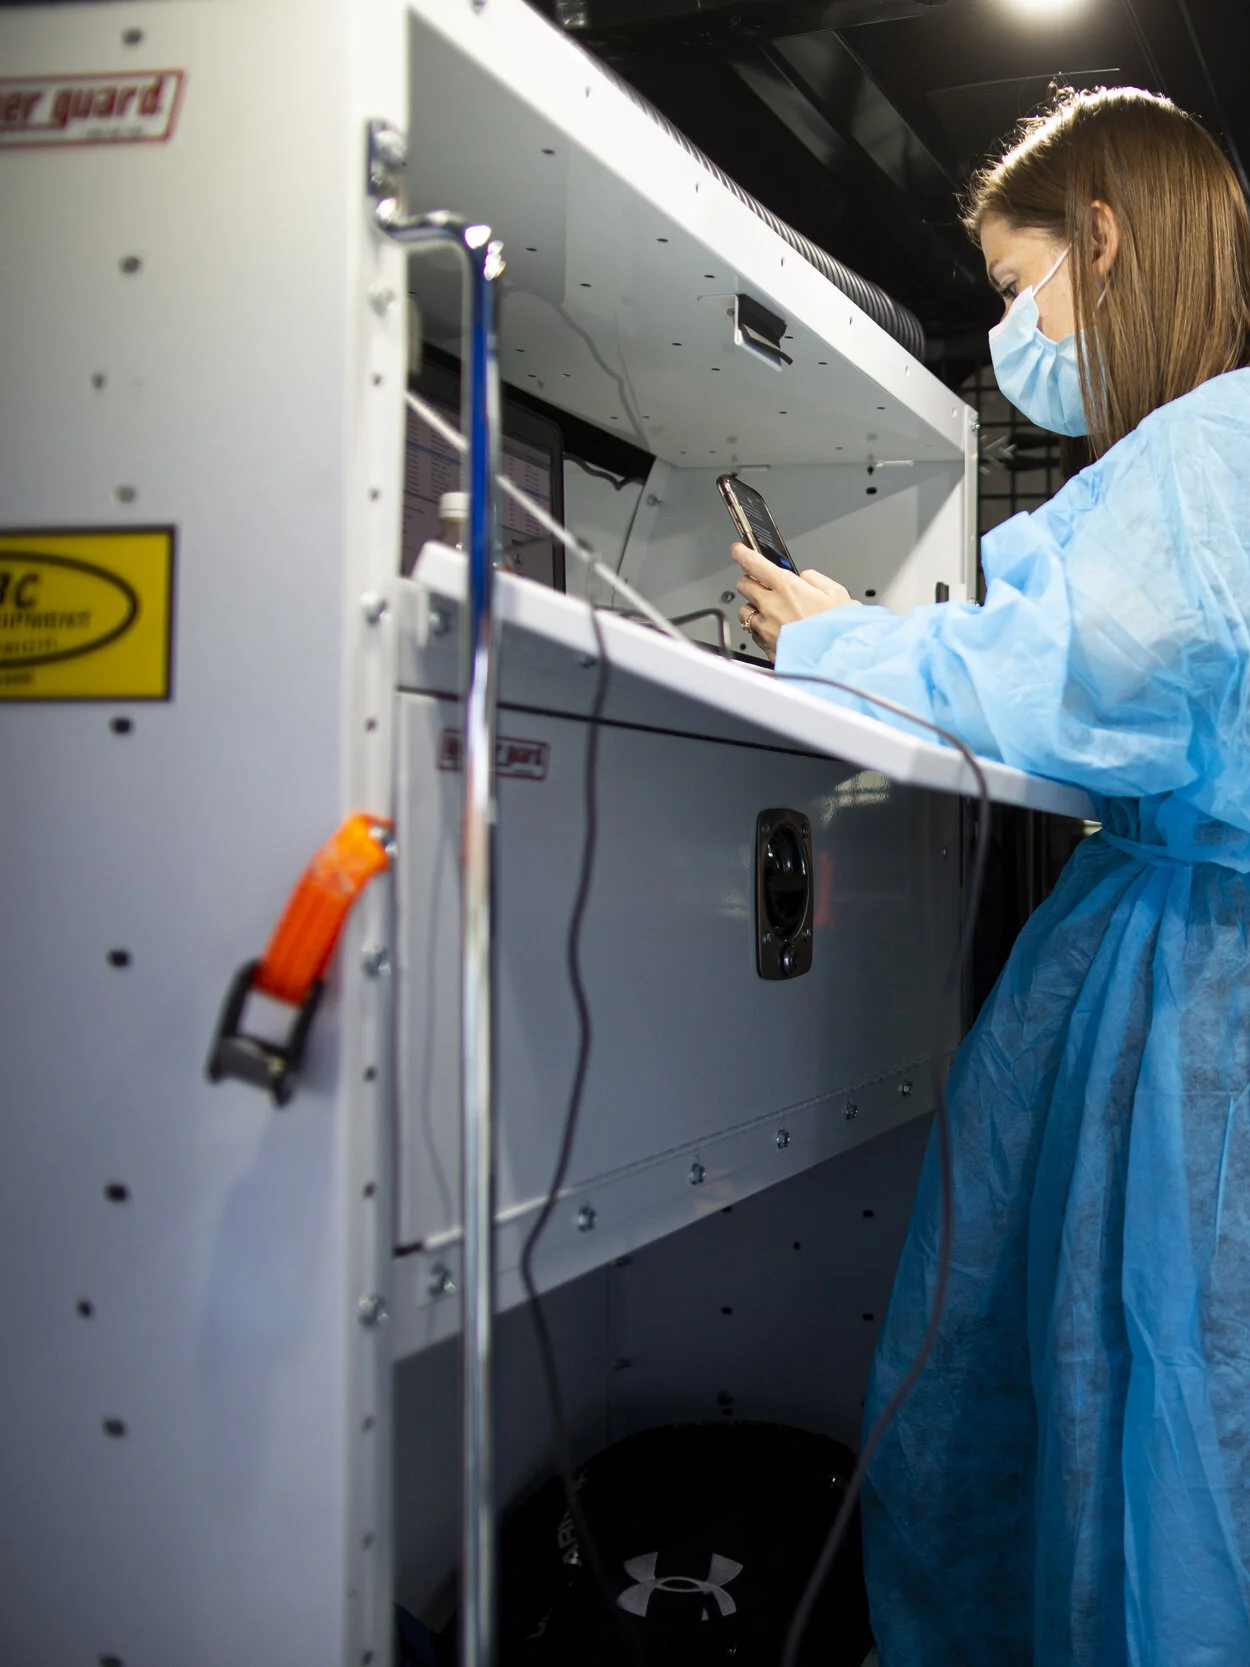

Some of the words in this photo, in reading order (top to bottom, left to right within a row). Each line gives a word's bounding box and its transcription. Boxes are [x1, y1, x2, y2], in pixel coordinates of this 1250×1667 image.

[0, 89, 43, 123] er
[51, 76, 164, 128] guard
[0, 610, 91, 630] IPMENT
